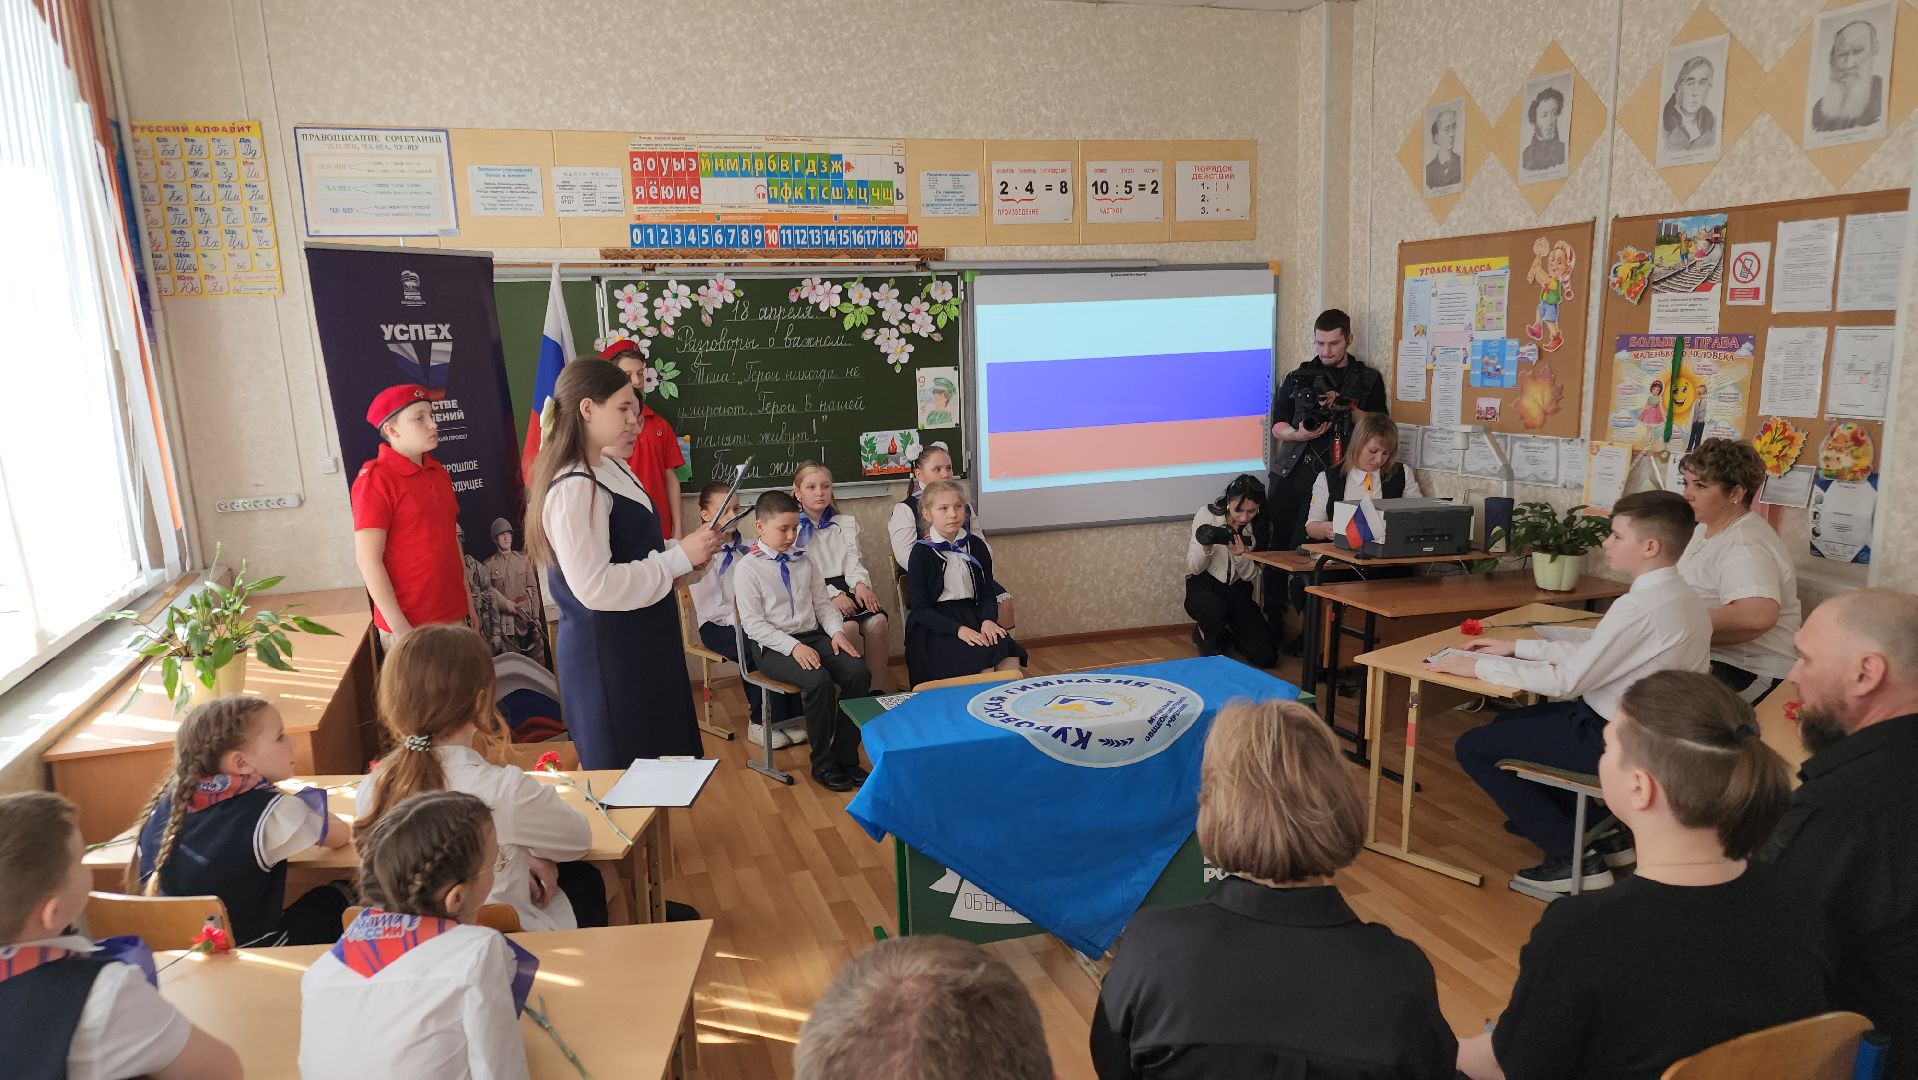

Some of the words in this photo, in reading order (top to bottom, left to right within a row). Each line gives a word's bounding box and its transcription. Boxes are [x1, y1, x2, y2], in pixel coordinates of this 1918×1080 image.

[131, 125, 189, 133] РУССКИЙ
[195, 125, 252, 134] АЛФАВИТ
[301, 133, 381, 143] ПРАВОПИСАНИЕ
[385, 133, 442, 144] СОЧЕТАНИЙ
[1194, 165, 1233, 173] ПОРЯДОК
[1191, 173, 1235, 181] ДЕЙСТВИЙ
[999, 181, 1009, 195] 2
[1024, 180, 1034, 195] 4
[1059, 180, 1068, 195] 8
[1091, 180, 1109, 195] 10
[1123, 180, 1133, 195] 5
[1150, 180, 1159, 195] 2
[1201, 182, 1209, 190] 1.
[1201, 194, 1209, 203] 2.
[1200, 206, 1209, 215] 3.
[632, 228, 641, 245] 0
[646, 228, 654, 245] 1
[660, 228, 669, 245] 2
[674, 228, 682, 245] 3
[687, 228, 697, 245] 4
[701, 228, 709, 245] 5
[714, 228, 723, 245] 6
[727, 228, 736, 245] 7
[741, 228, 749, 245] 8
[754, 228, 762, 245] 9
[766, 230, 778, 245] 10
[780, 230, 792, 245] 11
[795, 230, 807, 245] 12
[809, 230, 821, 245] 13
[823, 230, 835, 245] 14
[838, 230, 850, 245] 15
[852, 230, 864, 245] 16
[865, 230, 877, 245] 17
[879, 230, 891, 245] 18
[892, 230, 904, 245] 19
[905, 230, 918, 245] 20
[1420, 265, 1453, 276] УГОЛОК
[1456, 263, 1492, 274] КЛАССА
[731, 300, 751, 321] 18
[380, 323, 453, 342] УСПЕХ
[677, 325, 760, 366] Разговоры
[768, 338, 775, 348] о
[1629, 336, 1691, 348] БОЛЬШЕ
[1694, 336, 1740, 349] ПРАВА
[1690, 350, 1735, 362] ЧЕЛОВЕКА
[785, 368, 834, 392] никогда
[845, 366, 860, 378] не
[757, 391, 797, 423] Герои
[804, 393, 812, 411] в
[819, 394, 866, 412] нашей
[696, 432, 751, 448] памяти
[1004, 677, 1150, 695] ГИМНАЗИЯ
